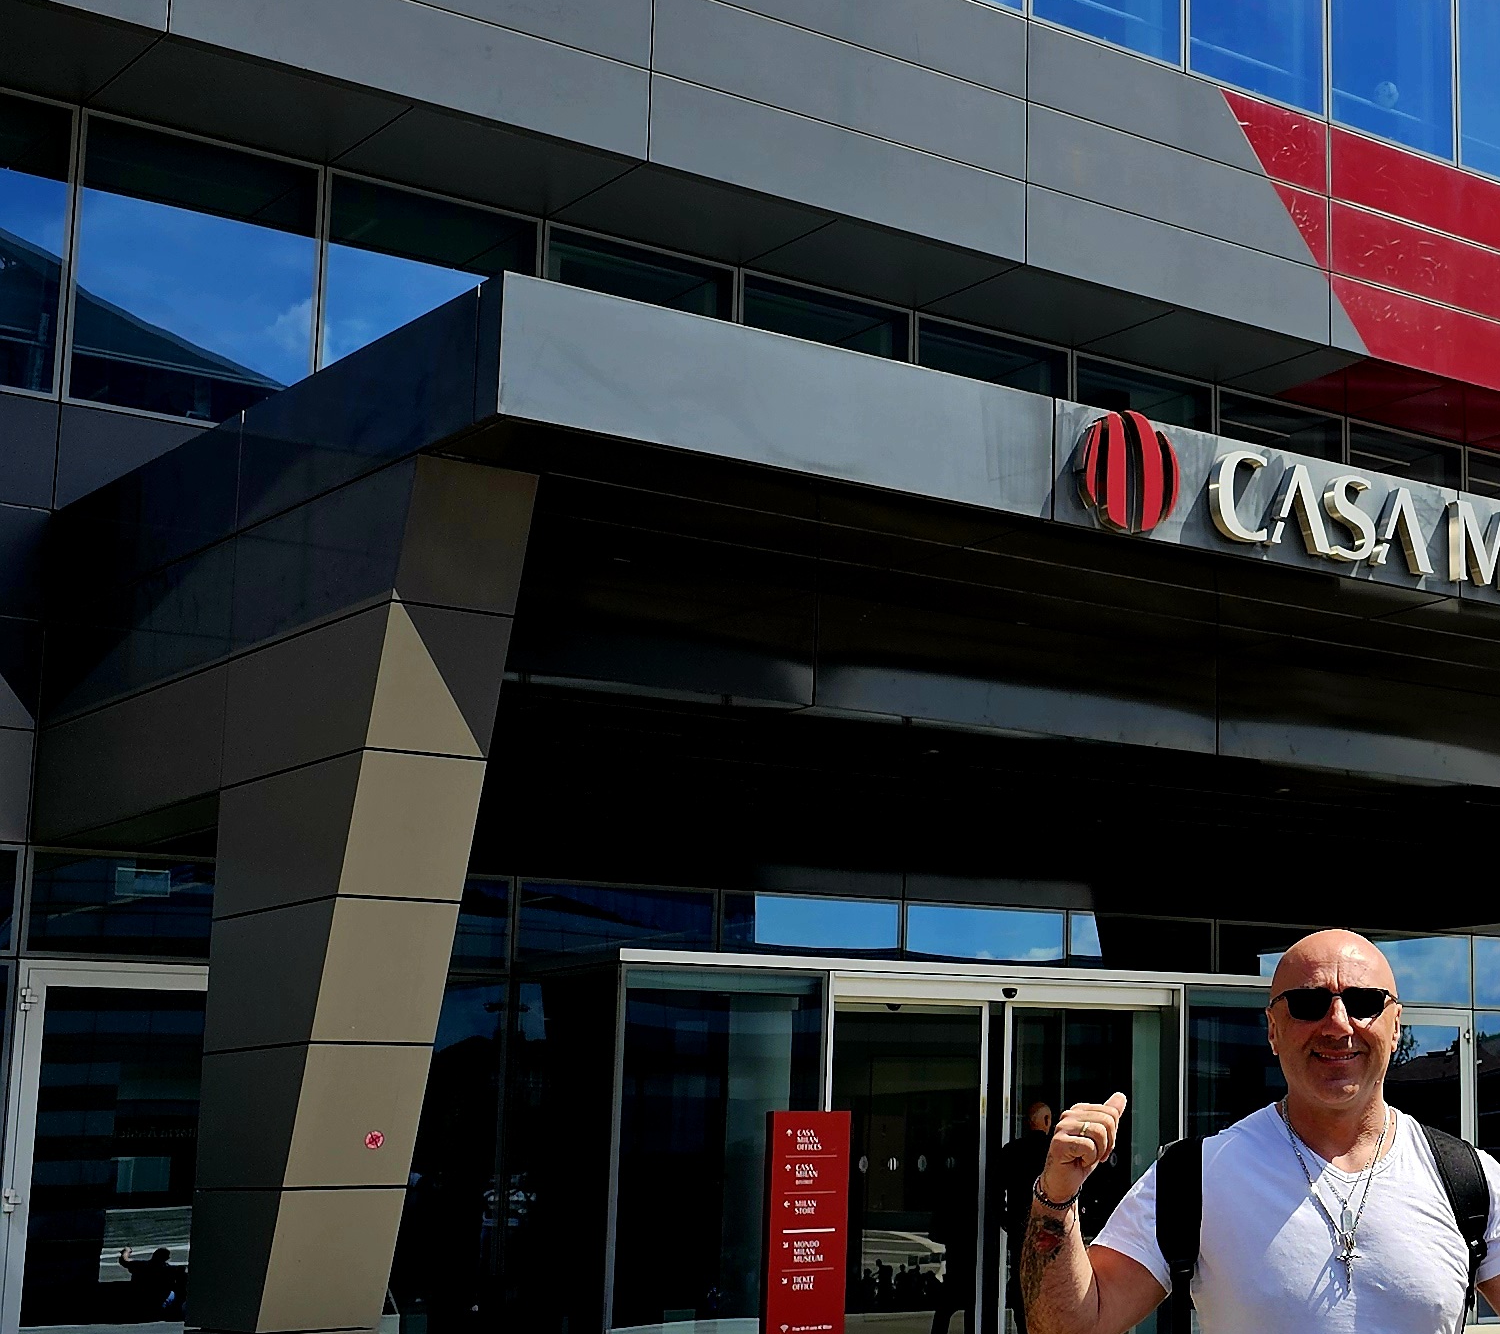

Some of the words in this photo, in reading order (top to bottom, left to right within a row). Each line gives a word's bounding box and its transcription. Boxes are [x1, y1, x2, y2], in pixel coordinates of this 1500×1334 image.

[1209, 449, 1435, 576] CASA
[797, 1129, 815, 1137] CASA
[795, 1163, 814, 1171] CASA
[794, 1199, 817, 1207] MILAN
[794, 1240, 820, 1248] MONDO
